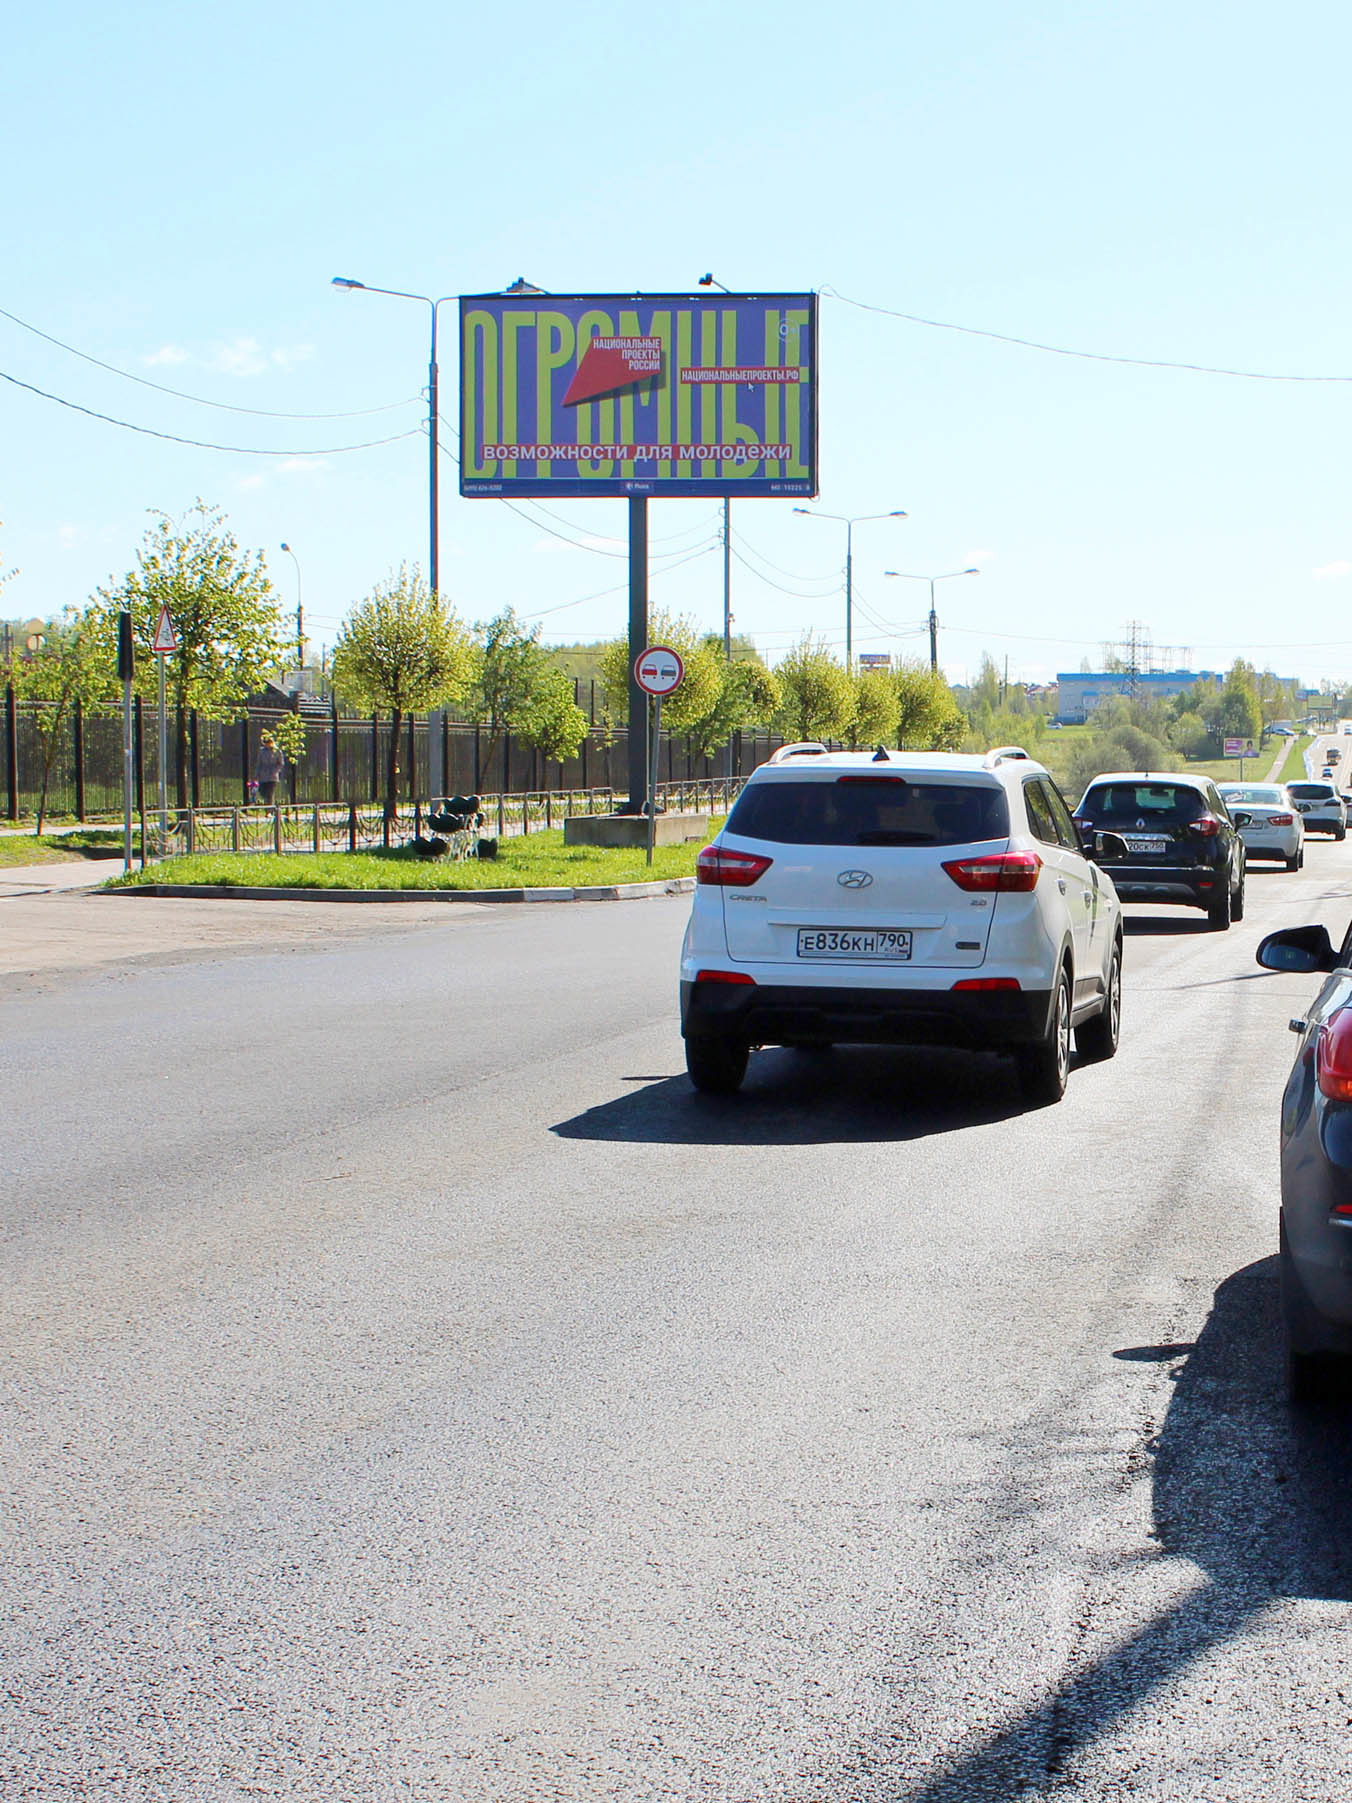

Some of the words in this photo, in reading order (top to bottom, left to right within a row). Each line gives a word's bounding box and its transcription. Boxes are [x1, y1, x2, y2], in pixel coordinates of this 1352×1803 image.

[593, 338, 660, 350] НАЦИОНАЛЬНЫЕ
[621, 349, 660, 360] ПРОЕКТЫ
[628, 360, 660, 371] РОССИИ
[681, 369, 799, 382] НАЦИОНАЛЬНЫЕПРОЕКТЫ.РФ
[464, 310, 809, 478] ОГРОМНЫЕ
[879, 933, 906, 948] 790
